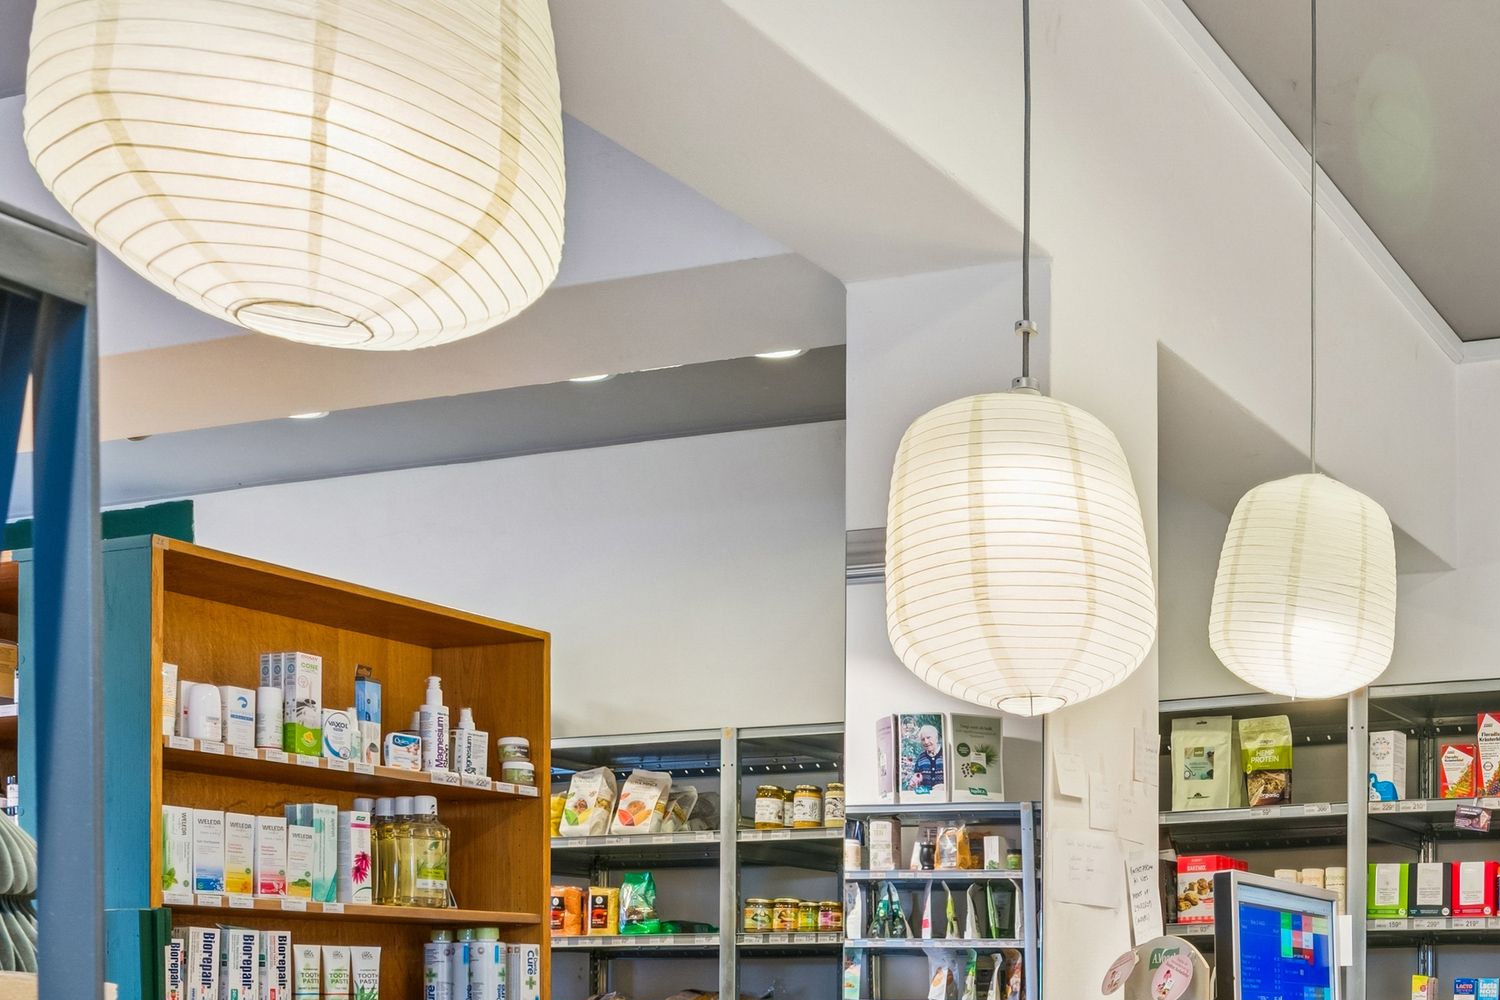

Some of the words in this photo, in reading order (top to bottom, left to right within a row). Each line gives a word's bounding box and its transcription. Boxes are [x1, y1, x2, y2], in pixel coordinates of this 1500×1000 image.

[328, 720, 349, 730] VAXOL
[434, 714, 445, 769] Magnesium
[1256, 749, 1275, 757] HEMP
[1250, 756, 1280, 764] PROTEIN
[197, 818, 222, 826] WELEDA
[229, 821, 253, 829] WELEDA
[261, 824, 285, 832] WELEDA
[292, 832, 313, 840] WELEDA
[199, 932, 216, 990] Biorepair
[239, 934, 256, 990] Biorepair
[276, 935, 288, 990] Biorepair
[169, 942, 181, 990] Biorepair
